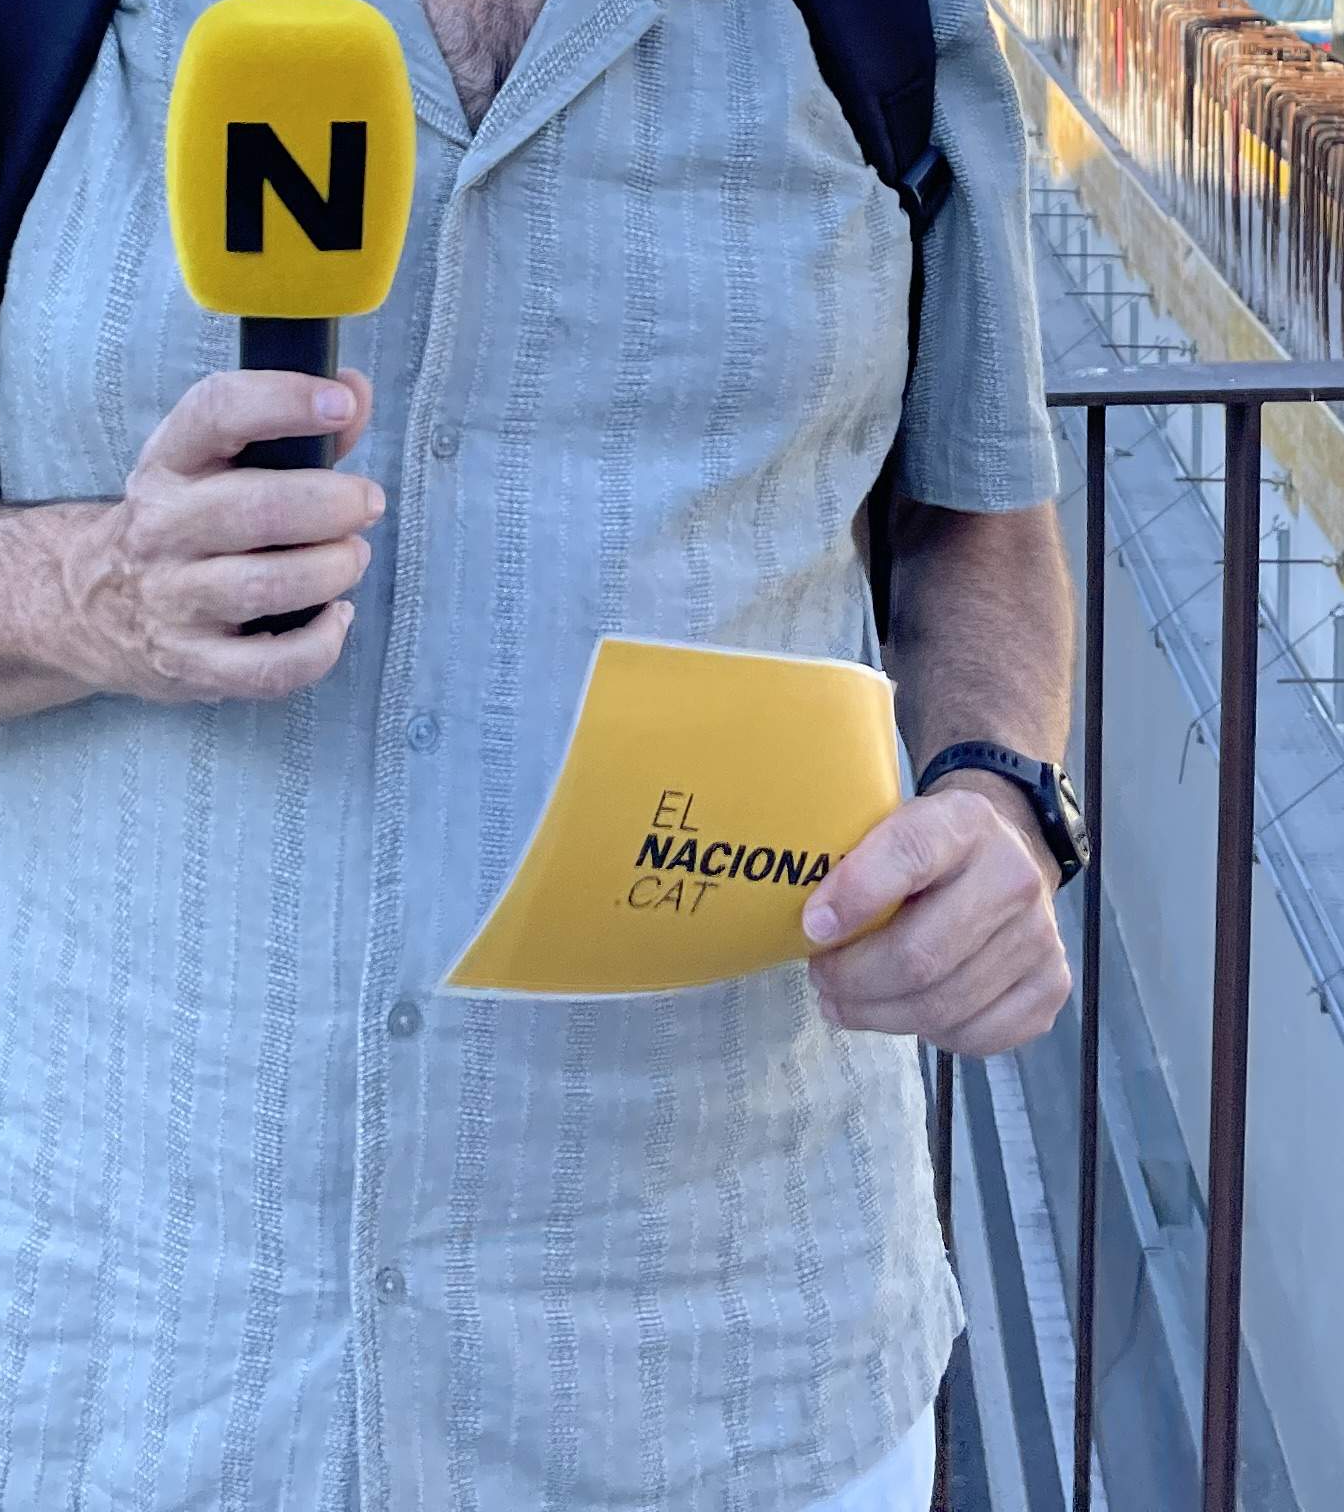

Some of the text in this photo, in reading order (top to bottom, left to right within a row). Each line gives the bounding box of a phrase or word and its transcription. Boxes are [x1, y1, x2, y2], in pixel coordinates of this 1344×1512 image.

[226, 121, 367, 252] N
[653, 789, 698, 831] EL
[635, 833, 846, 886] NACIONA
